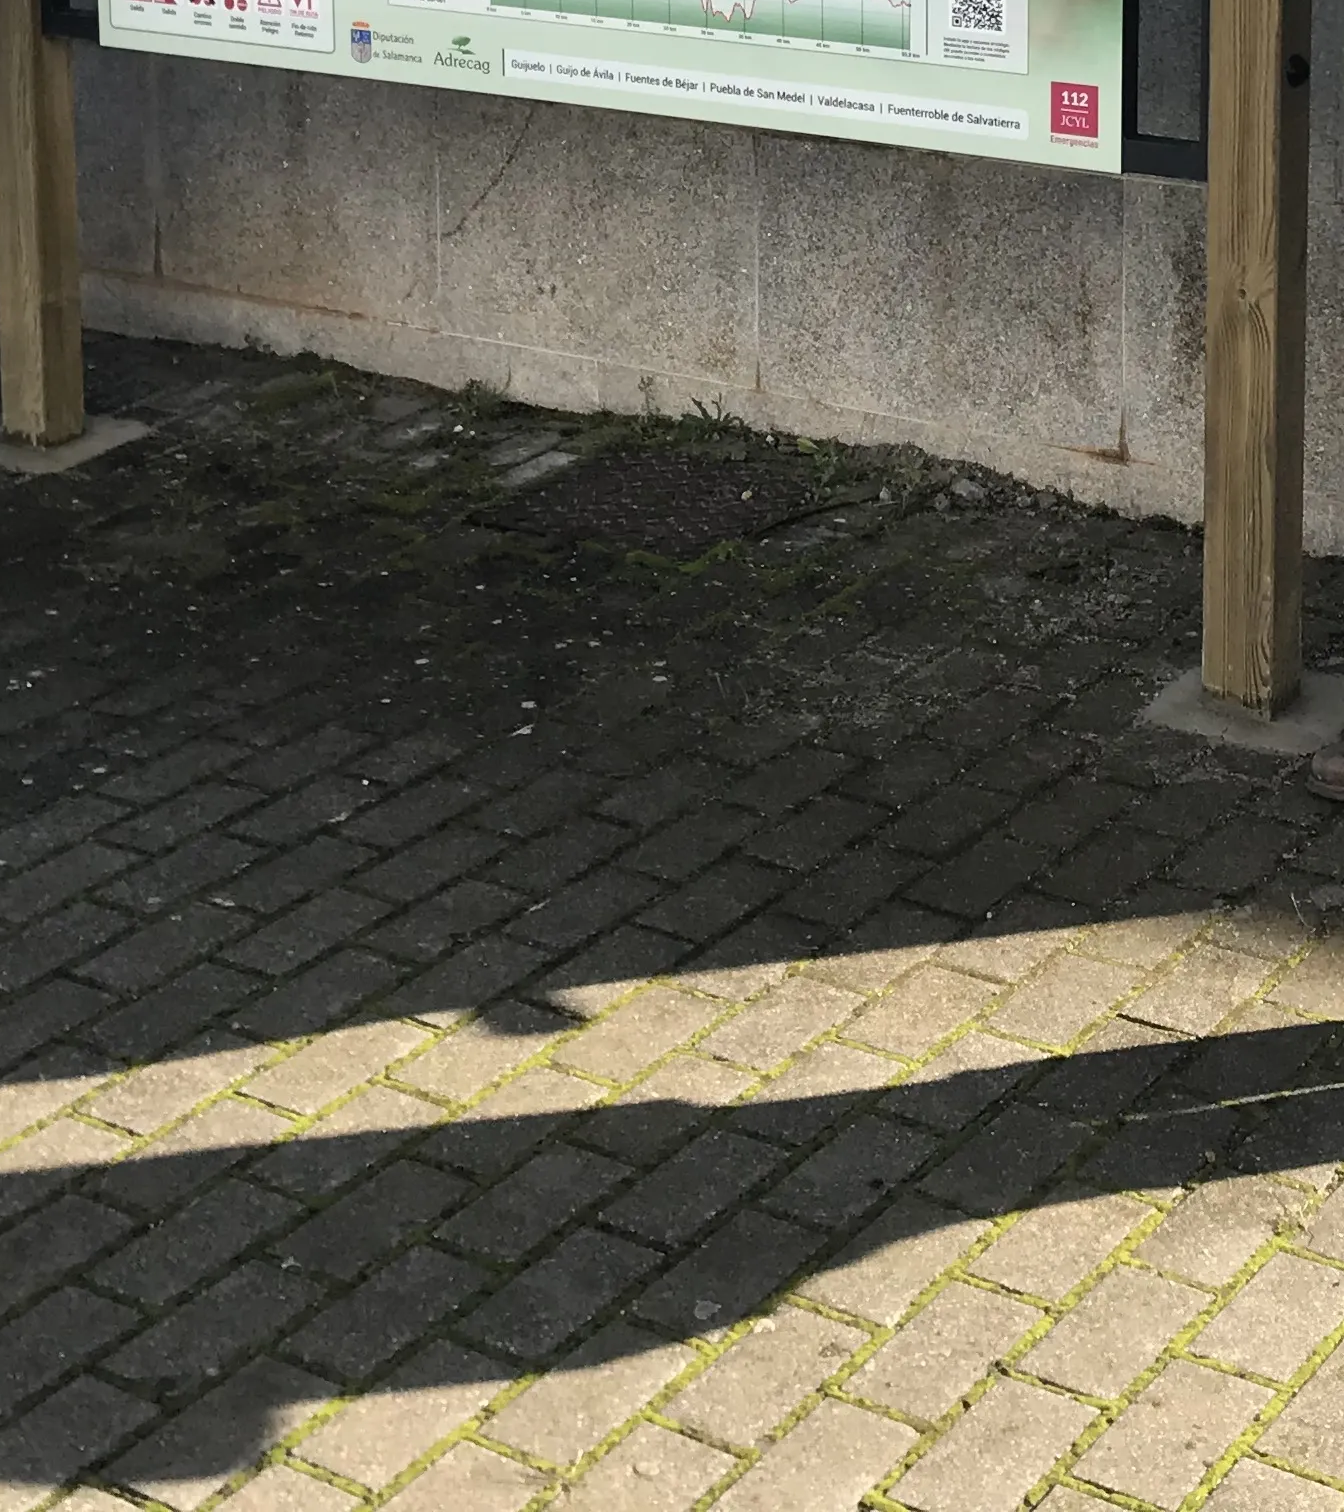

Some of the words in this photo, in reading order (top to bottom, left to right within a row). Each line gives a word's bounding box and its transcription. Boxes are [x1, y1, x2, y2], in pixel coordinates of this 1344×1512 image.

[372, 31, 415, 45] Diputación
[382, 50, 423, 64] Salamanca
[433, 51, 491, 75] Adrecag
[511, 59, 546, 74] Guijuelo
[556, 64, 579, 79] Guijo
[580, 66, 591, 78] de
[593, 65, 614, 81] Ávila
[625, 72, 660, 87] Fuentes
[662, 75, 673, 88] de
[675, 76, 699, 92] Béjar
[710, 82, 742, 96] Puebla
[743, 85, 755, 98] de
[757, 87, 775, 100] San
[776, 89, 805, 104] Medel
[817, 95, 875, 112] Valdelacasa
[887, 103, 950, 122] Fuenterroble
[951, 110, 964, 123] de
[966, 113, 1021, 130] Salvatierra
[1061, 90, 1089, 108] 112
[1060, 115, 1090, 129] JCYL
[1050, 134, 1098, 149] Emergencias
